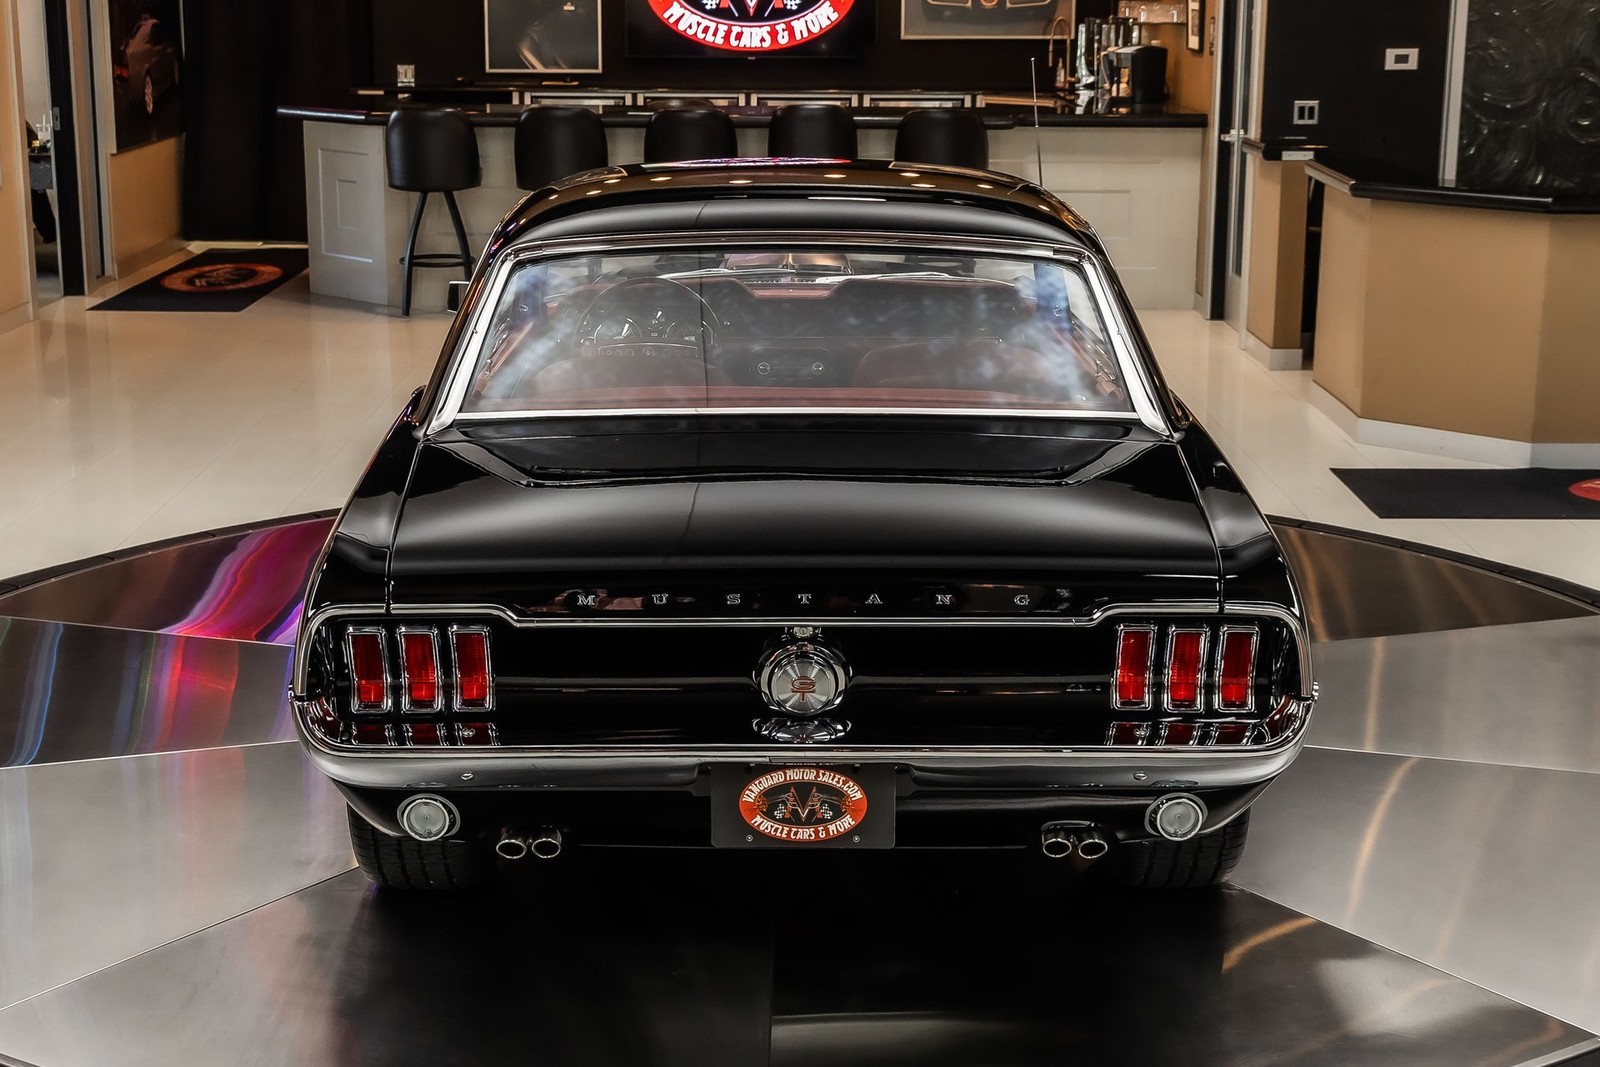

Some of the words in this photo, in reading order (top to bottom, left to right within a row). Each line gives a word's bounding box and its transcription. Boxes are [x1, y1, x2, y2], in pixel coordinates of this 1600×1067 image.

[662, 1, 728, 45] MUSCLE
[729, 26, 771, 48] CARS
[775, 23, 789, 45] &
[791, 1, 839, 40] MORE
[577, 593, 1030, 606] MUSTANG
[742, 771, 785, 802] VANGUARD
[785, 769, 817, 780] MOTOR
[817, 770, 863, 801] SALES.COM
[751, 815, 789, 838] MUSCLE
[790, 827, 815, 839] CARS
[818, 826, 826, 838] &
[827, 815, 855, 836] MORE
